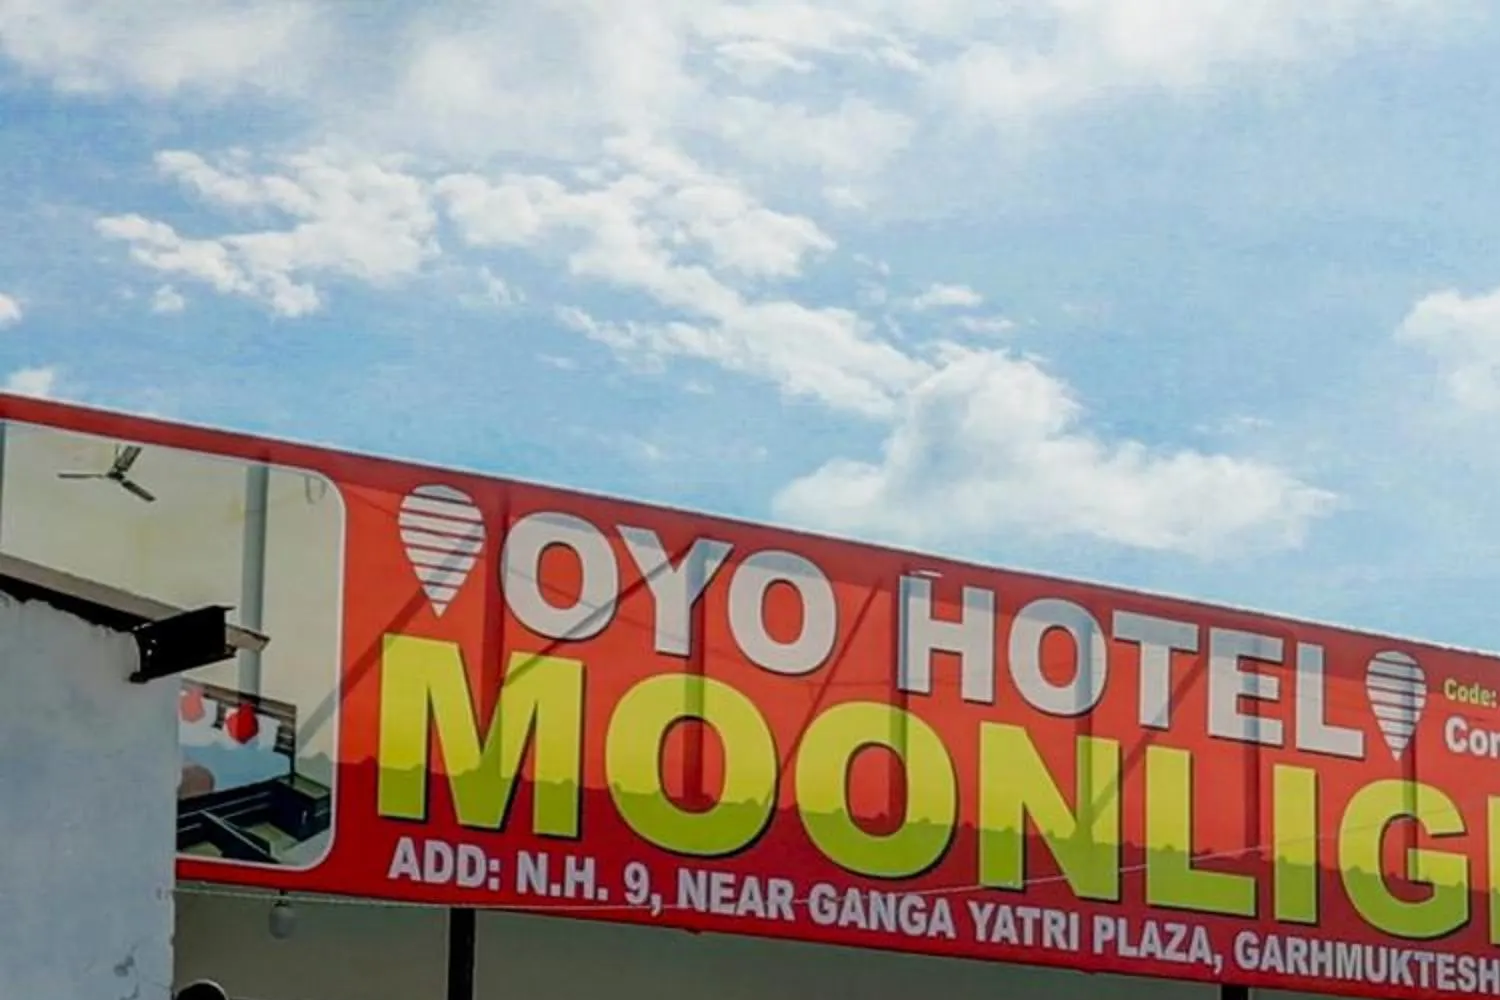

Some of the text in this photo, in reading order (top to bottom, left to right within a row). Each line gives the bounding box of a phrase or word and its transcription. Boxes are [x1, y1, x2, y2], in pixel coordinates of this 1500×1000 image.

[501, 511, 1364, 759] OYO HOTEL
[1443, 678, 1497, 708] Code:
[388, 837, 501, 891] ADD:
[515, 851, 608, 901] N.H.
[623, 861, 663, 916] 9,
[677, 869, 796, 921] NEAR
[808, 884, 957, 939] GANGA
[967, 902, 1080, 951] YATRI
[1091, 915, 1223, 974] PLAZA,
